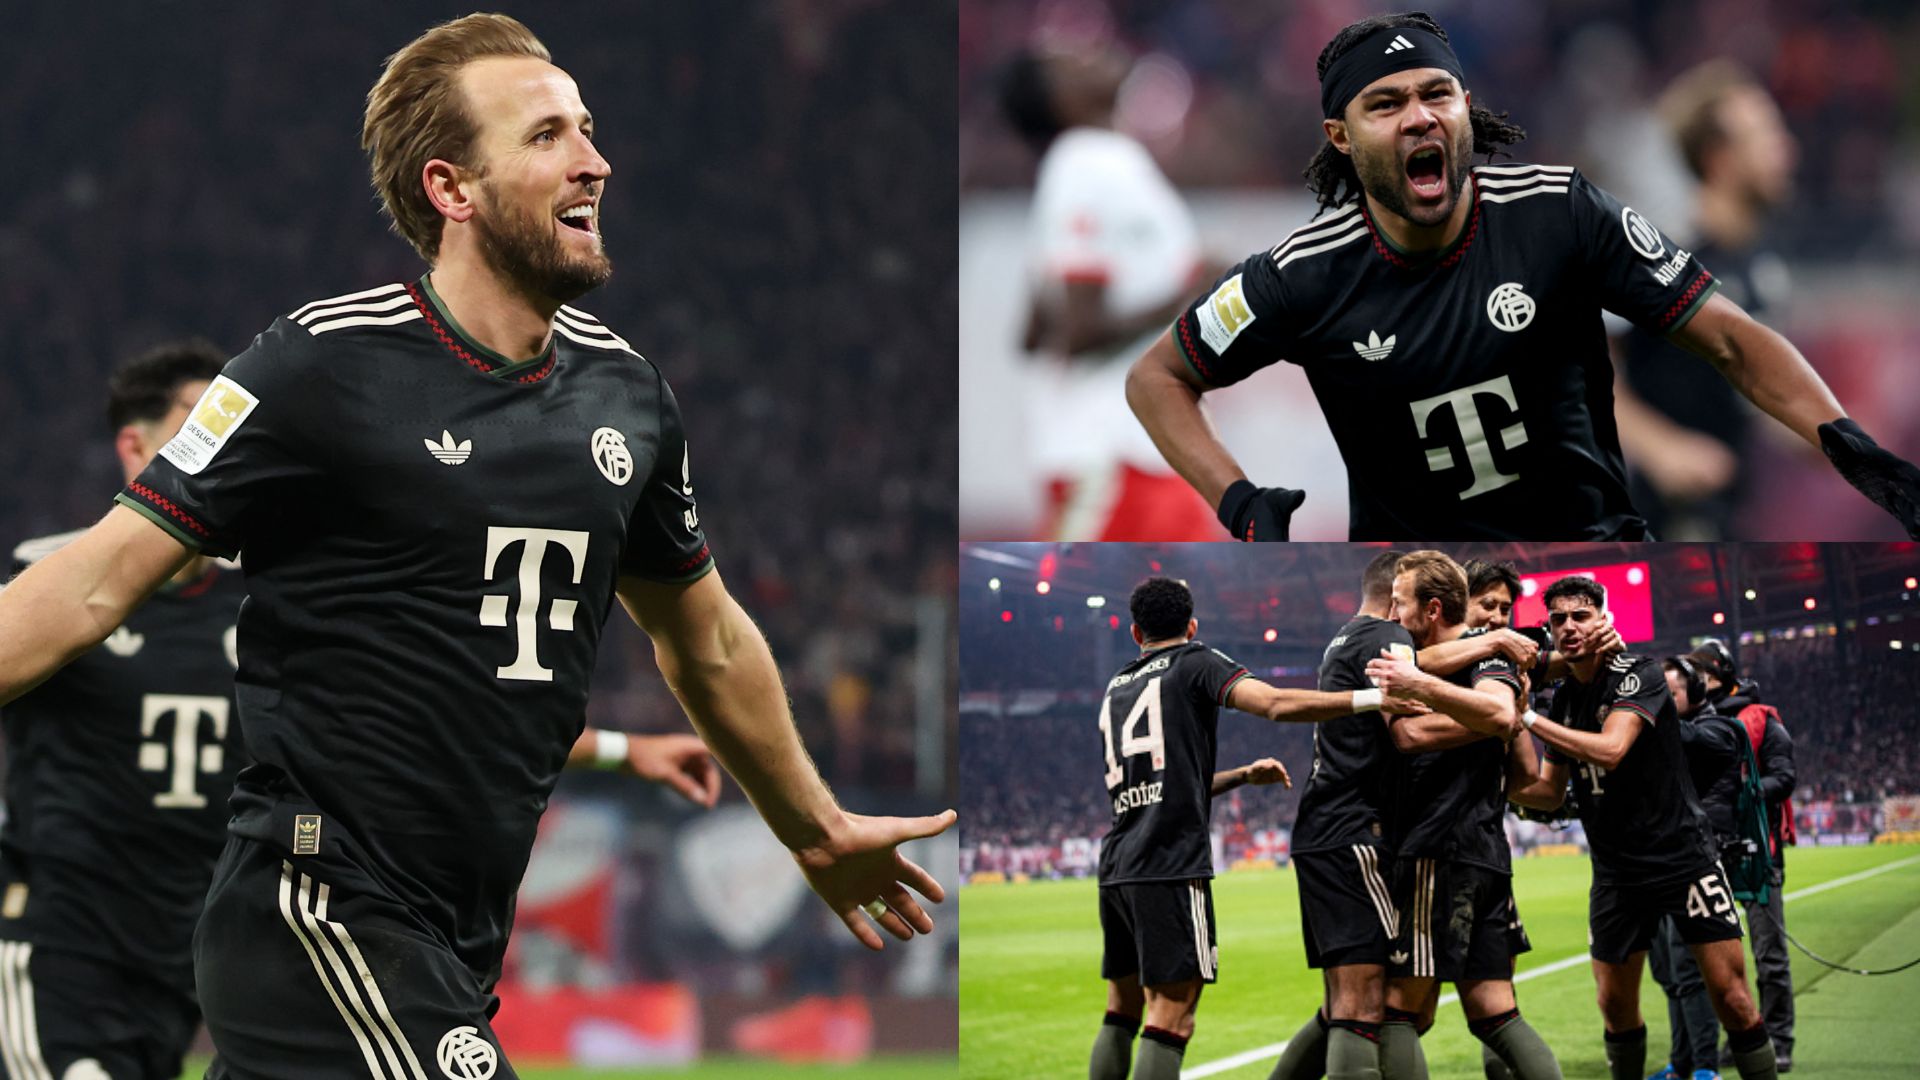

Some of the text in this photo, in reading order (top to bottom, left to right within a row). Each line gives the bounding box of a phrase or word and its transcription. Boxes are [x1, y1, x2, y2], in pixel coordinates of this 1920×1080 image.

[1653, 248, 1693, 288] Allianz
[1409, 374, 1529, 501] T
[478, 526, 590, 682] T
[137, 693, 230, 810] T
[1098, 676, 1166, 791] 14
[1130, 779, 1164, 809] DÍAZ
[1686, 873, 1733, 919] 45
